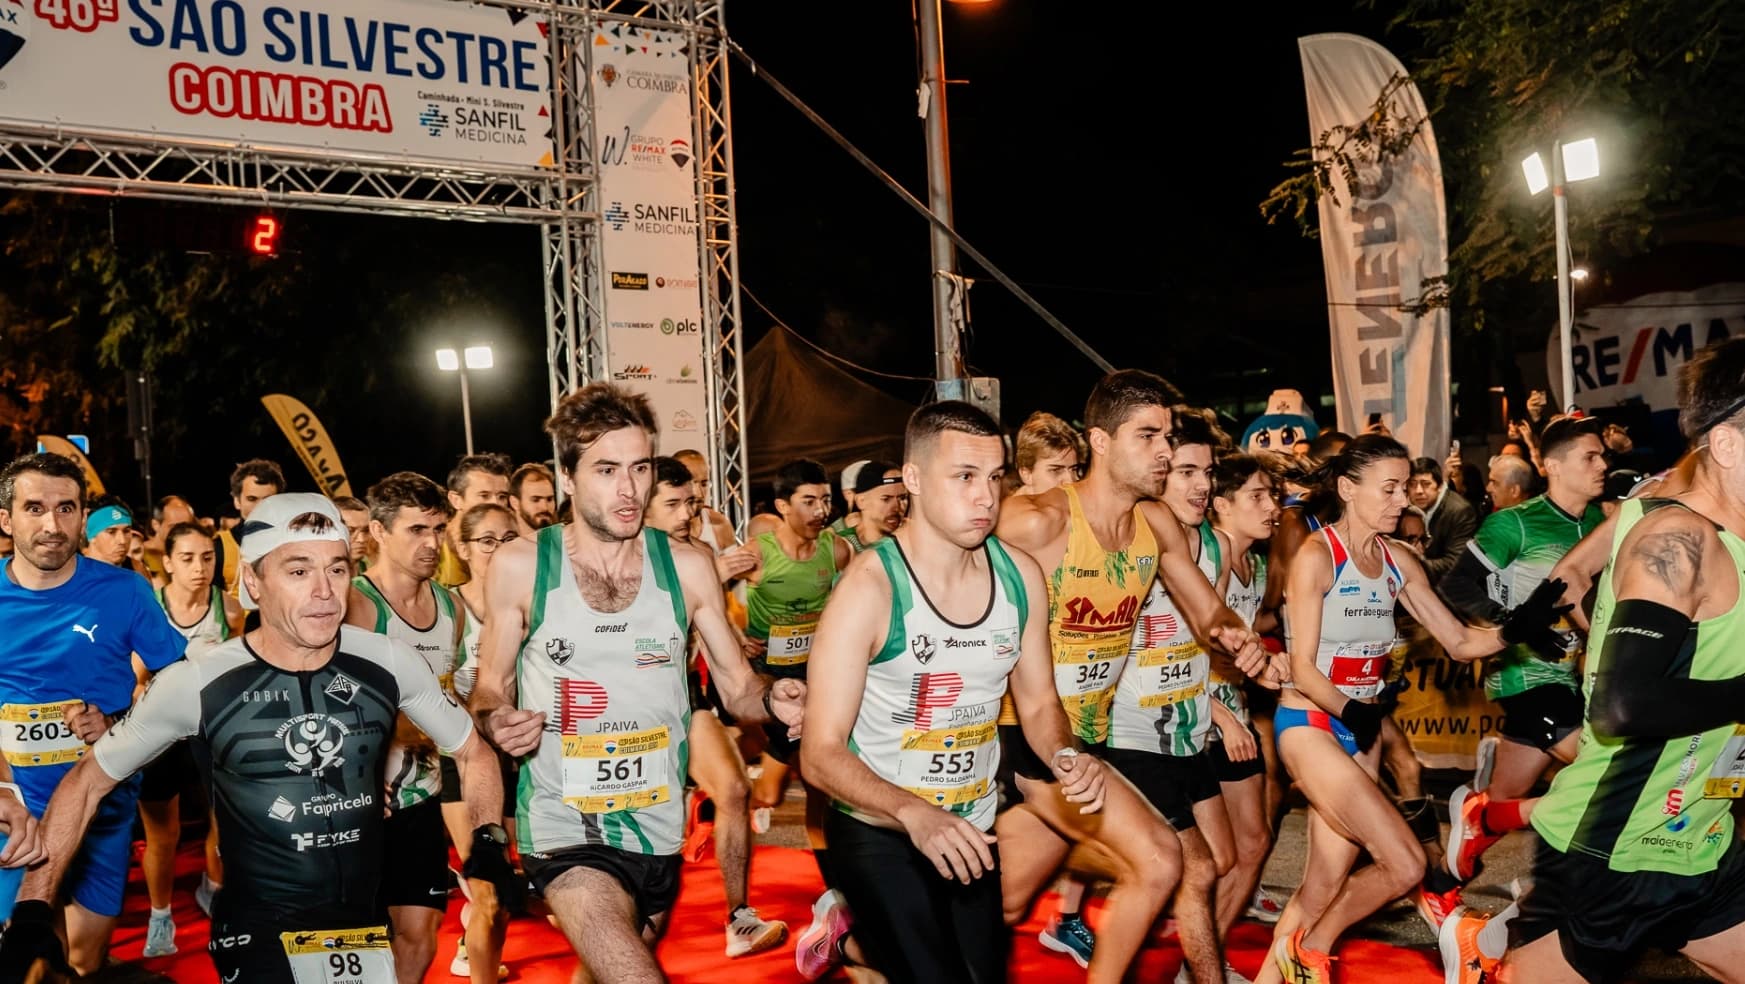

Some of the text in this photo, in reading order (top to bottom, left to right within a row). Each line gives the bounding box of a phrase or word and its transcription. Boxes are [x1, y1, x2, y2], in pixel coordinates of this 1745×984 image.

[263, 7, 540, 92] SILVESTRE
[627, 76, 688, 95] COIMBRA
[169, 62, 392, 134] COIMBRA
[418, 90, 459, 103] Caminhada
[466, 96, 482, 105] Mini
[493, 99, 525, 110] Silvestre
[455, 106, 527, 132] SANFIL
[455, 128, 527, 145] MEDICINA
[631, 143, 666, 155] RE/MAX
[632, 154, 663, 164] WHITE
[634, 203, 695, 224] SANFIL
[255, 218, 277, 251] 2
[634, 221, 694, 236] MEDICINA
[677, 318, 697, 336] plc
[595, 622, 631, 633] COFIDES
[785, 636, 809, 650] 501
[1076, 661, 1110, 684] 342
[1160, 662, 1192, 683] 544
[1361, 659, 1373, 675] 4
[242, 689, 292, 703] GOBIK
[275, 712, 327, 741] MULTISPORT
[597, 757, 643, 782] 561
[928, 750, 975, 774] 553
[920, 775, 945, 783] PEDRO
[329, 952, 363, 978] 98
